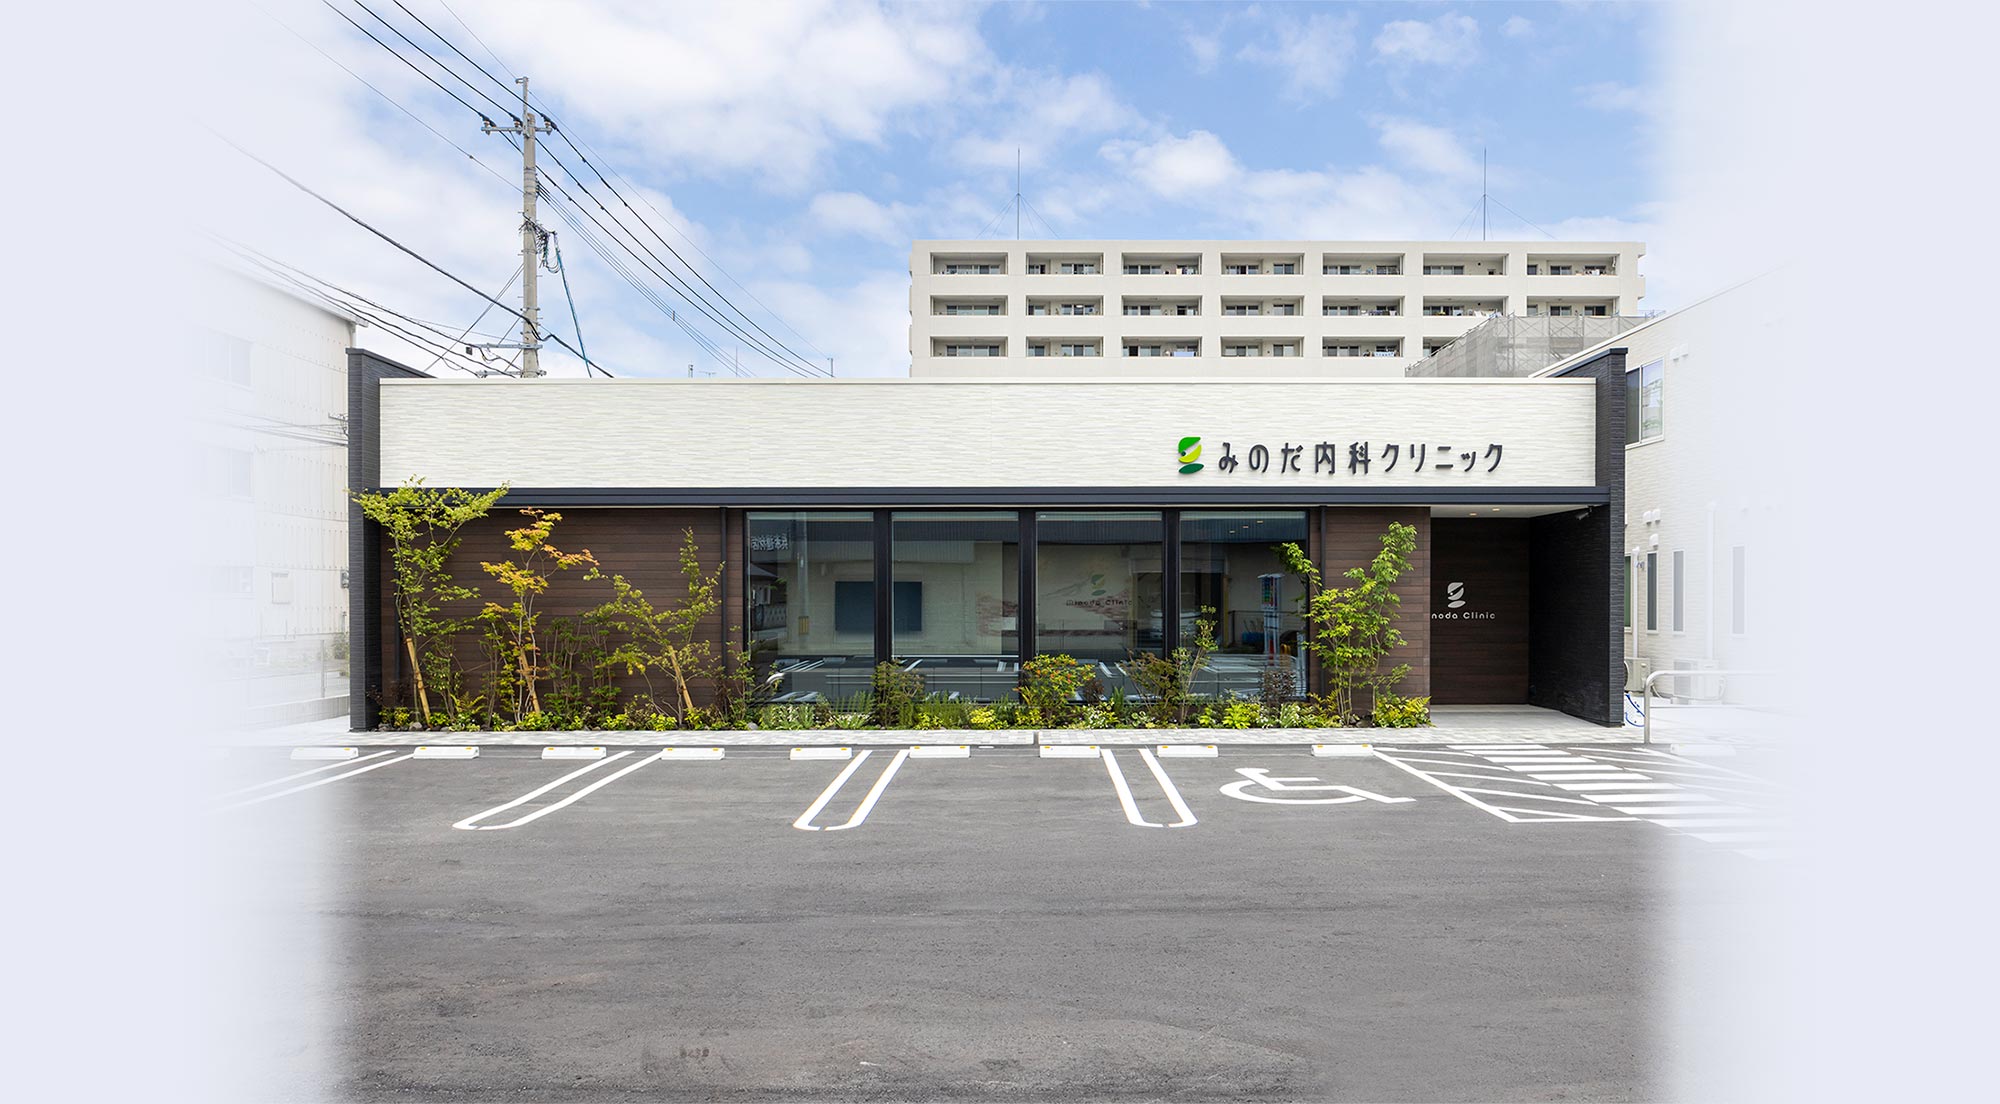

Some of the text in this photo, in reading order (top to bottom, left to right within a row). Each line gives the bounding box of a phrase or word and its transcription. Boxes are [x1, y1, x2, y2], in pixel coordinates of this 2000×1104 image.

[1218, 441, 1503, 475] みのだ内科クリニック
[1462, 611, 1496, 620] Clinic
